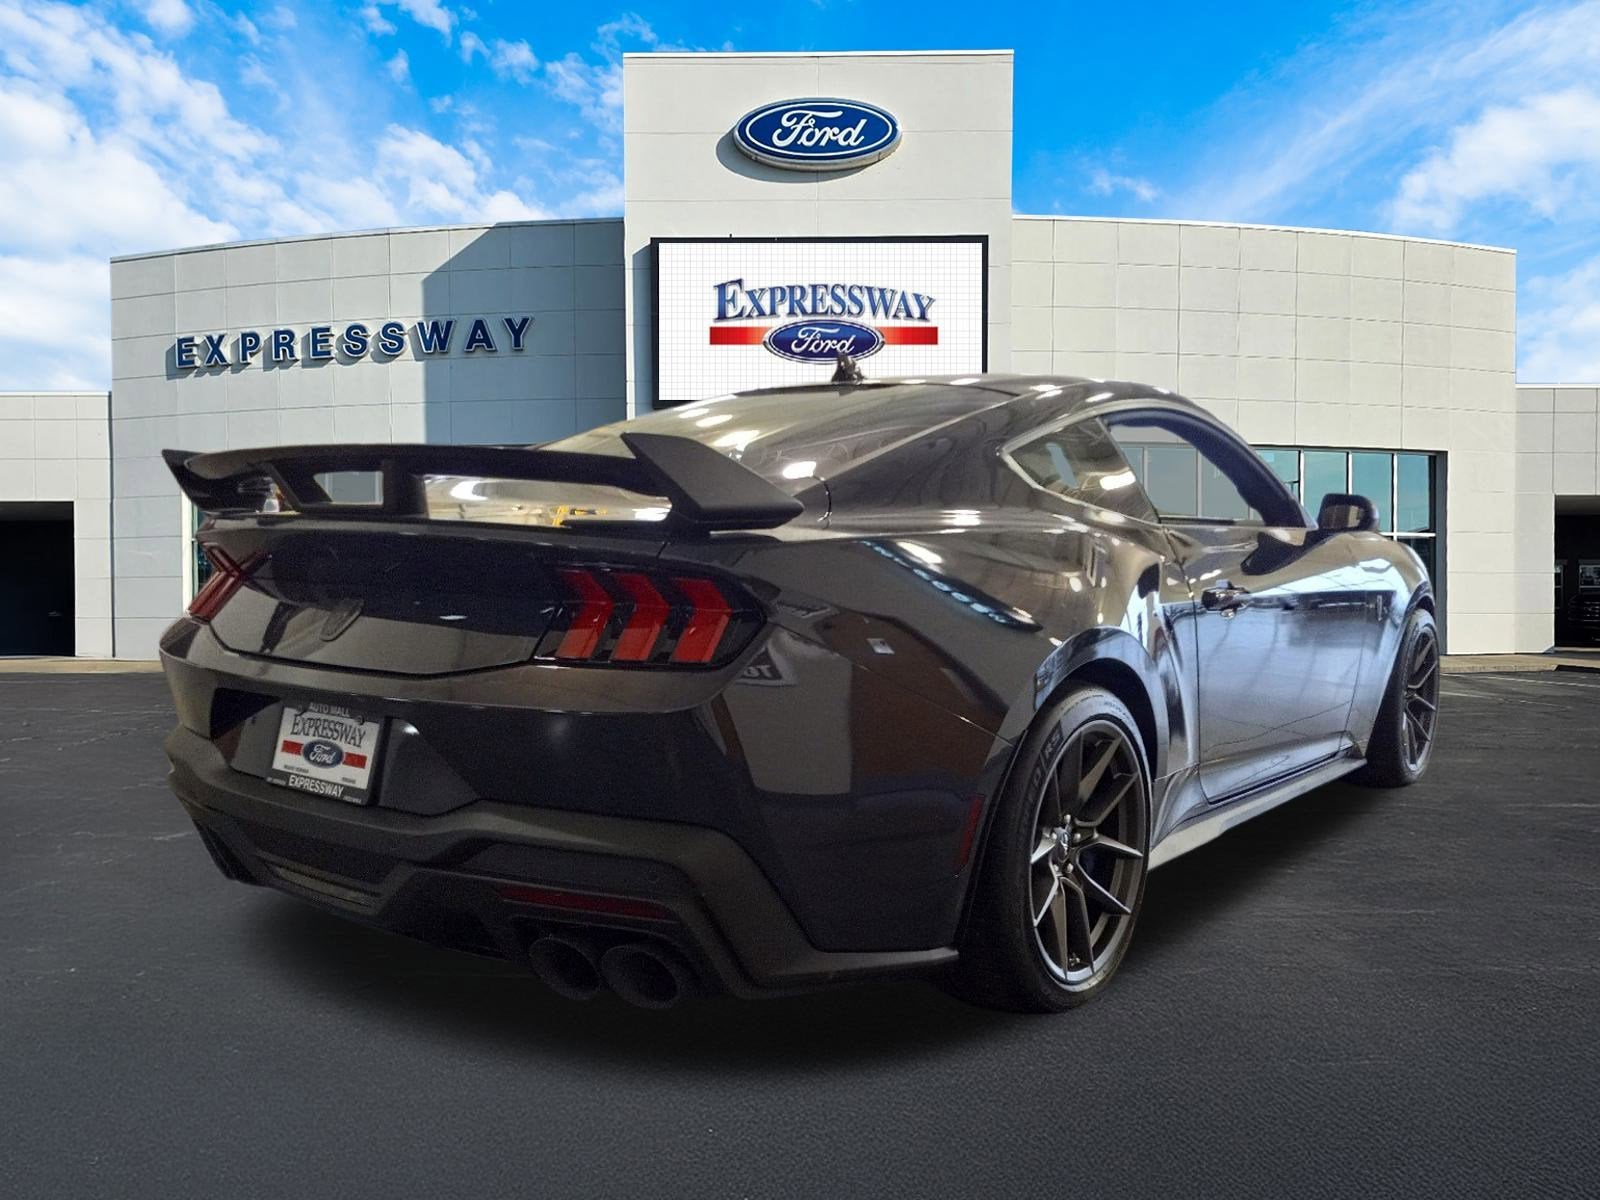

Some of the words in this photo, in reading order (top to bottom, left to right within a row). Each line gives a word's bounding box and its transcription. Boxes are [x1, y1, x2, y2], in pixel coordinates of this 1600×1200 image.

[771, 109, 867, 148] Ford
[714, 278, 935, 323] EXPRESSWAY
[175, 316, 535, 369] EXPRESSWAY
[791, 326, 854, 353] Ford
[307, 702, 329, 714] AUTO
[331, 705, 351, 717] MALL
[290, 714, 366, 748] EXPRESSWAY
[309, 744, 336, 763] Ford
[288, 775, 344, 798] EXPRESSWAY
